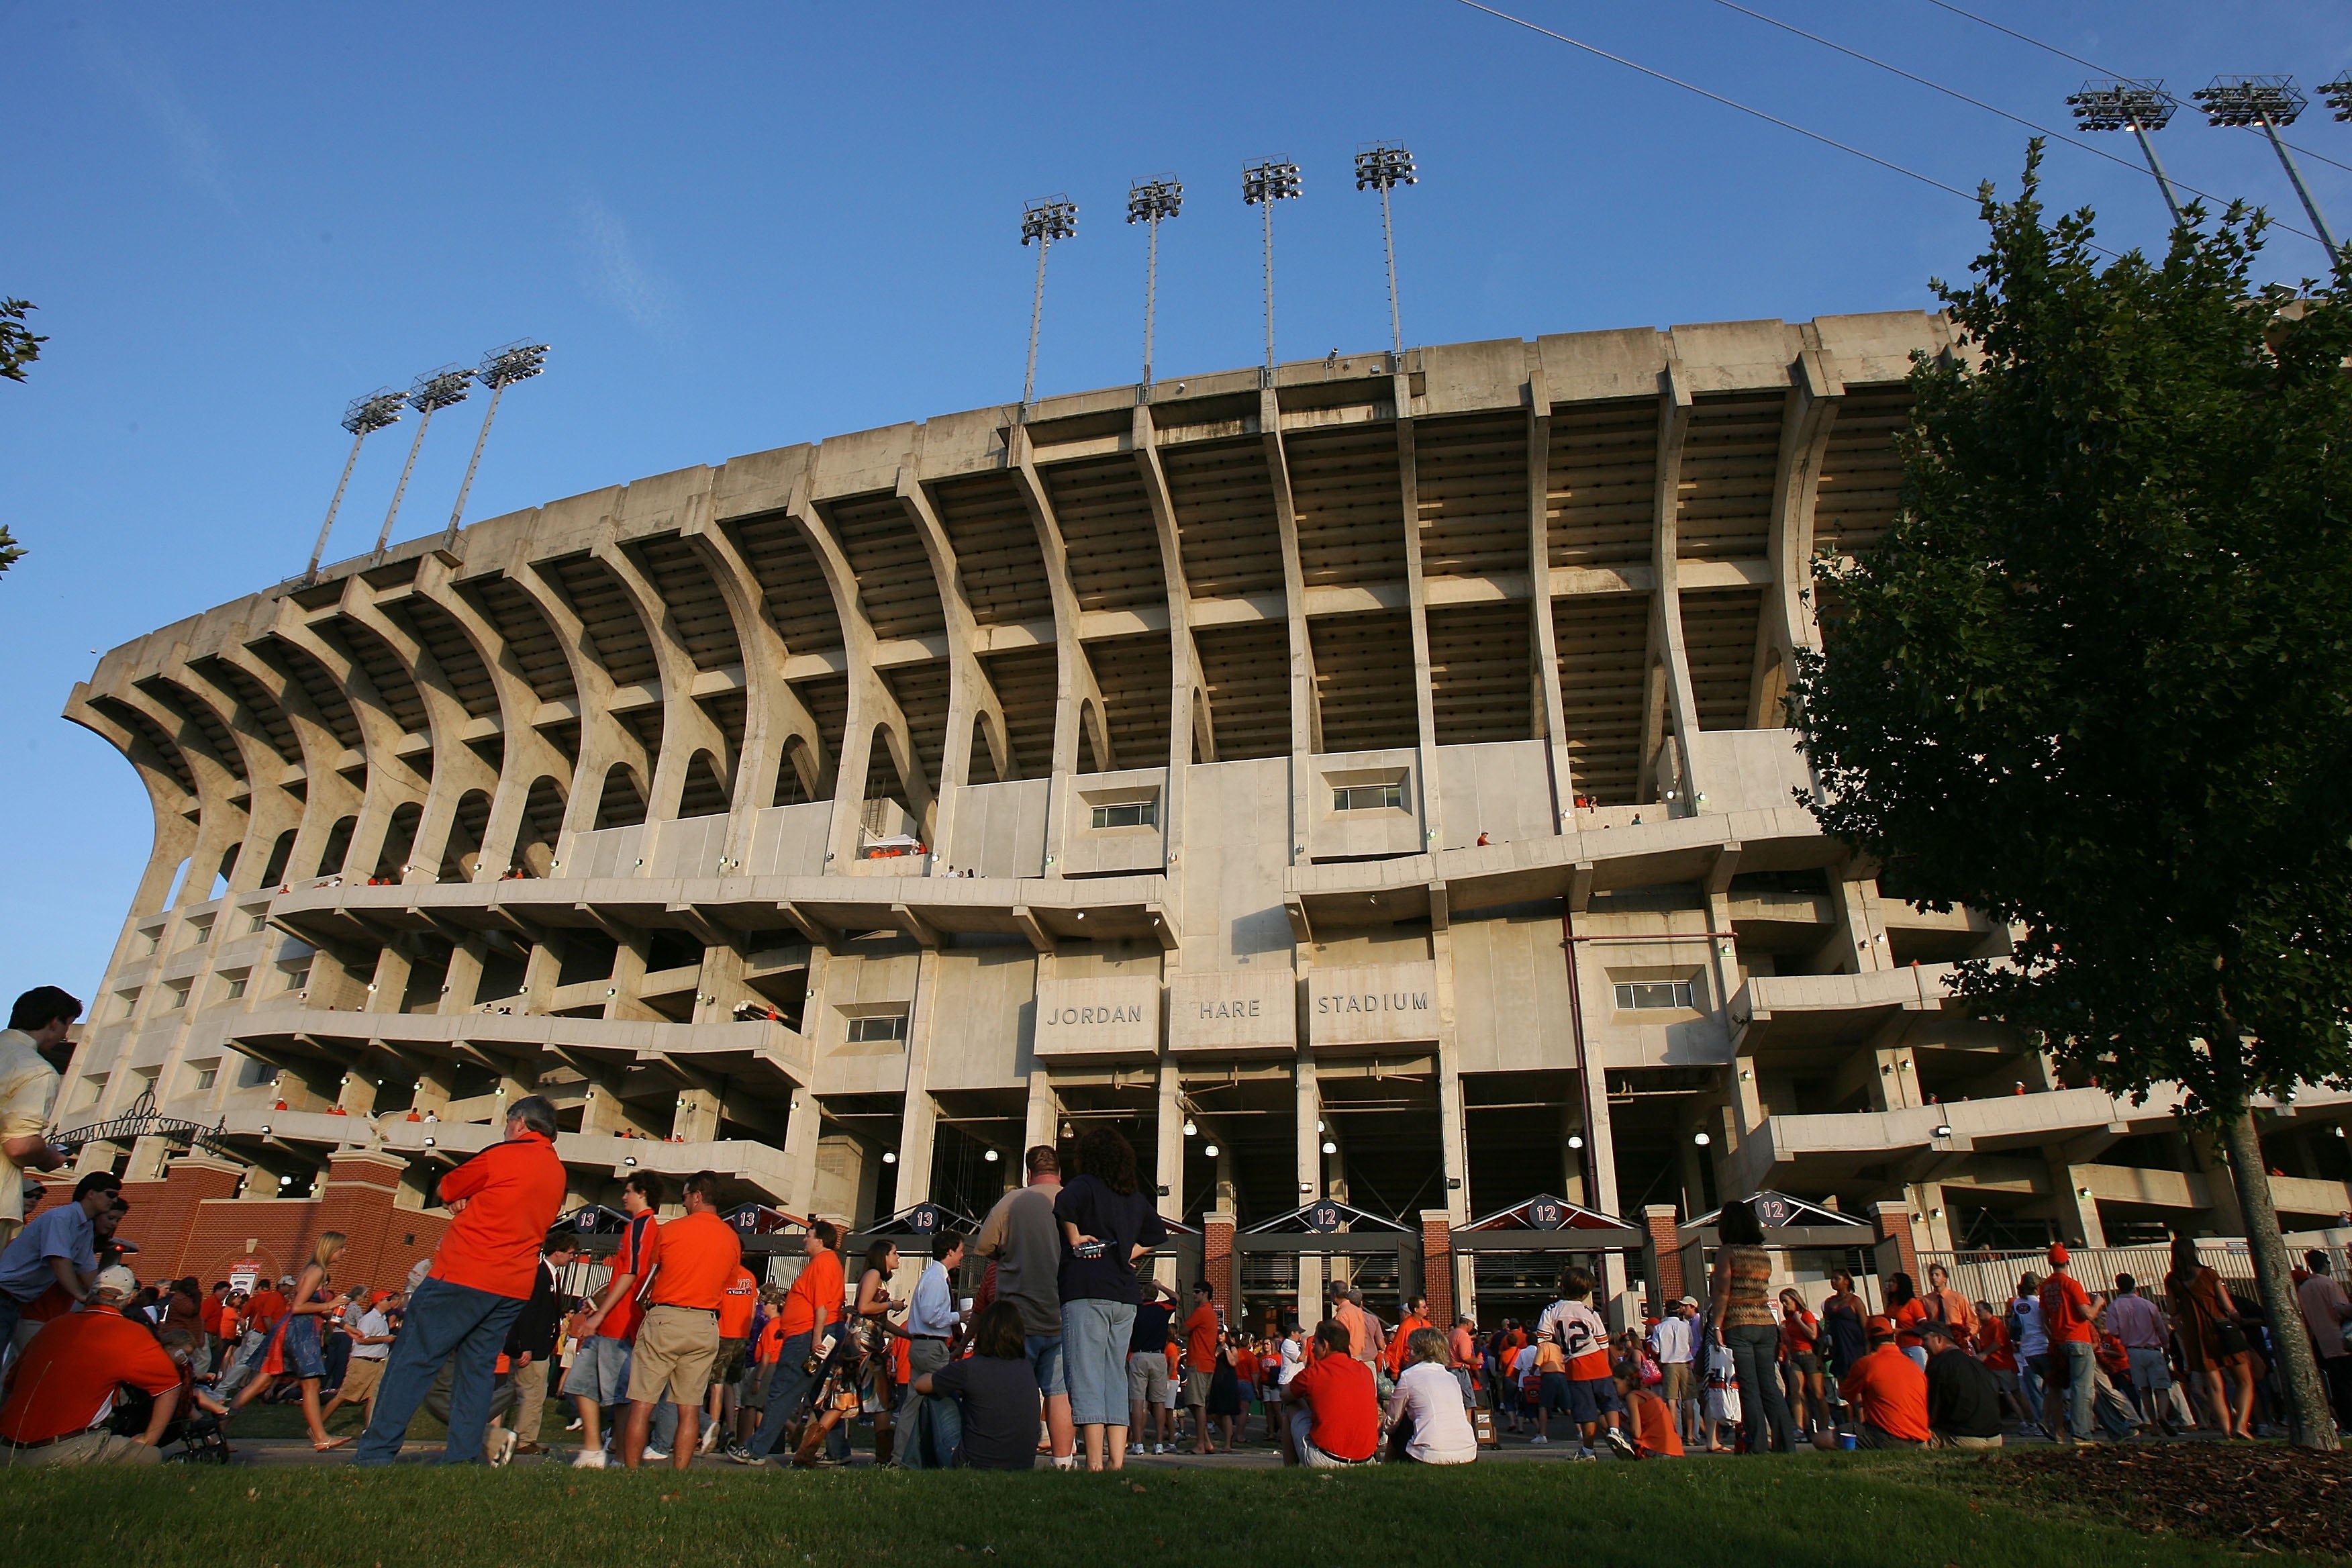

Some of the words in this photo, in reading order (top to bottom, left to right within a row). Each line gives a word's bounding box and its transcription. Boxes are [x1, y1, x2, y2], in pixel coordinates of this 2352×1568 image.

[1046, 1005, 1142, 1026] JORDAN
[1199, 999, 1261, 1020] HARE
[1318, 991, 1428, 1014] STADIUM
[110, 1118, 154, 1138] HARE
[1317, 1208, 1336, 1224] 12
[1536, 1205, 1557, 1222] 12
[1763, 1201, 1784, 1218] 12
[580, 1212, 595, 1227] 13
[740, 1212, 756, 1227] 13
[917, 1212, 934, 1227] 13
[1555, 1320, 1590, 1355] 12
